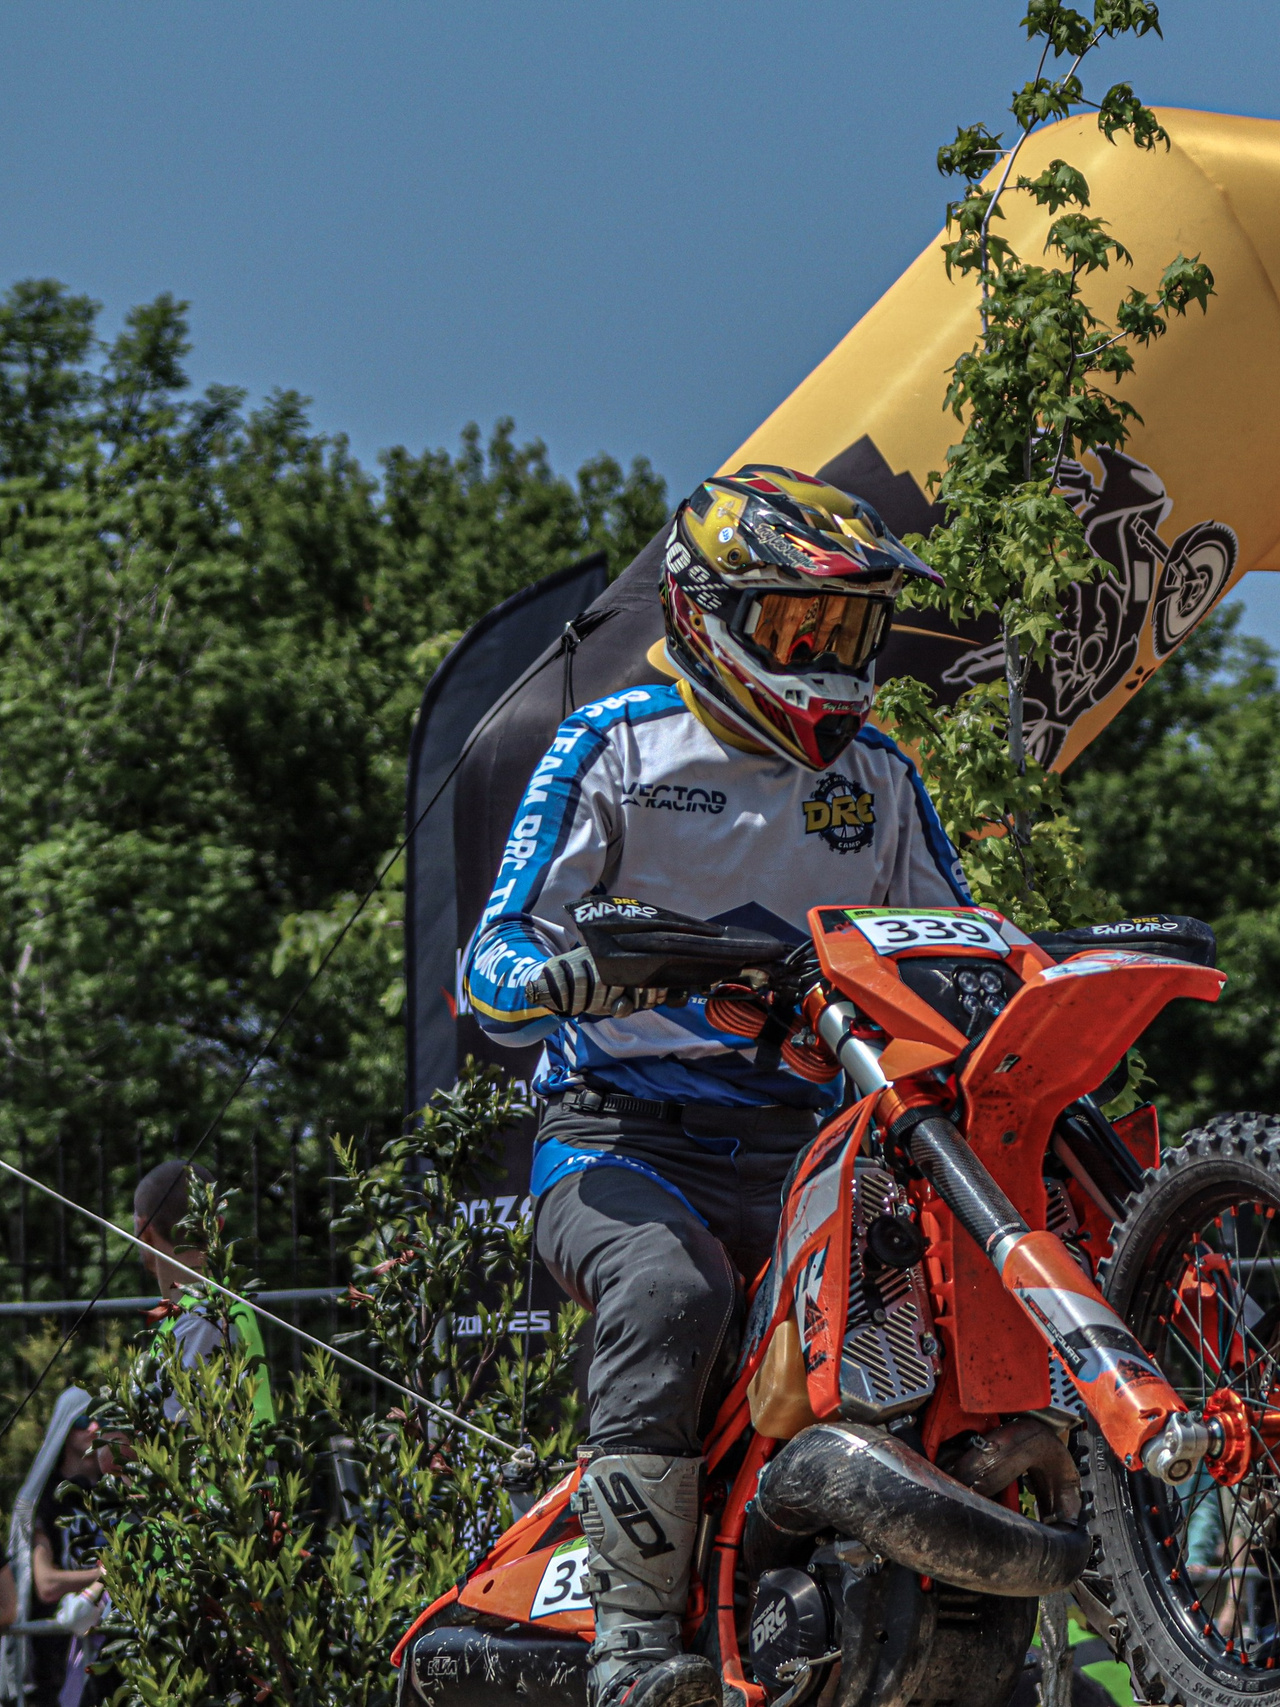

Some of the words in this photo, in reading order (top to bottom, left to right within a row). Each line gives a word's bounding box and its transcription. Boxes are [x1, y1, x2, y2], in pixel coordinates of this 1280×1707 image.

[523, 723, 590, 807] TEAM
[645, 798, 725, 815] RACING
[803, 793, 876, 834] DRC
[498, 814, 542, 877] DRC
[574, 901, 658, 923] ENDURO
[612, 897, 640, 906] DRC
[1091, 922, 1179, 935] ENDURO
[1131, 916, 1160, 924] DRC
[875, 919, 991, 944] 339
[752, 1596, 787, 1654] DRC
[427, 1656, 458, 1676] KTM
